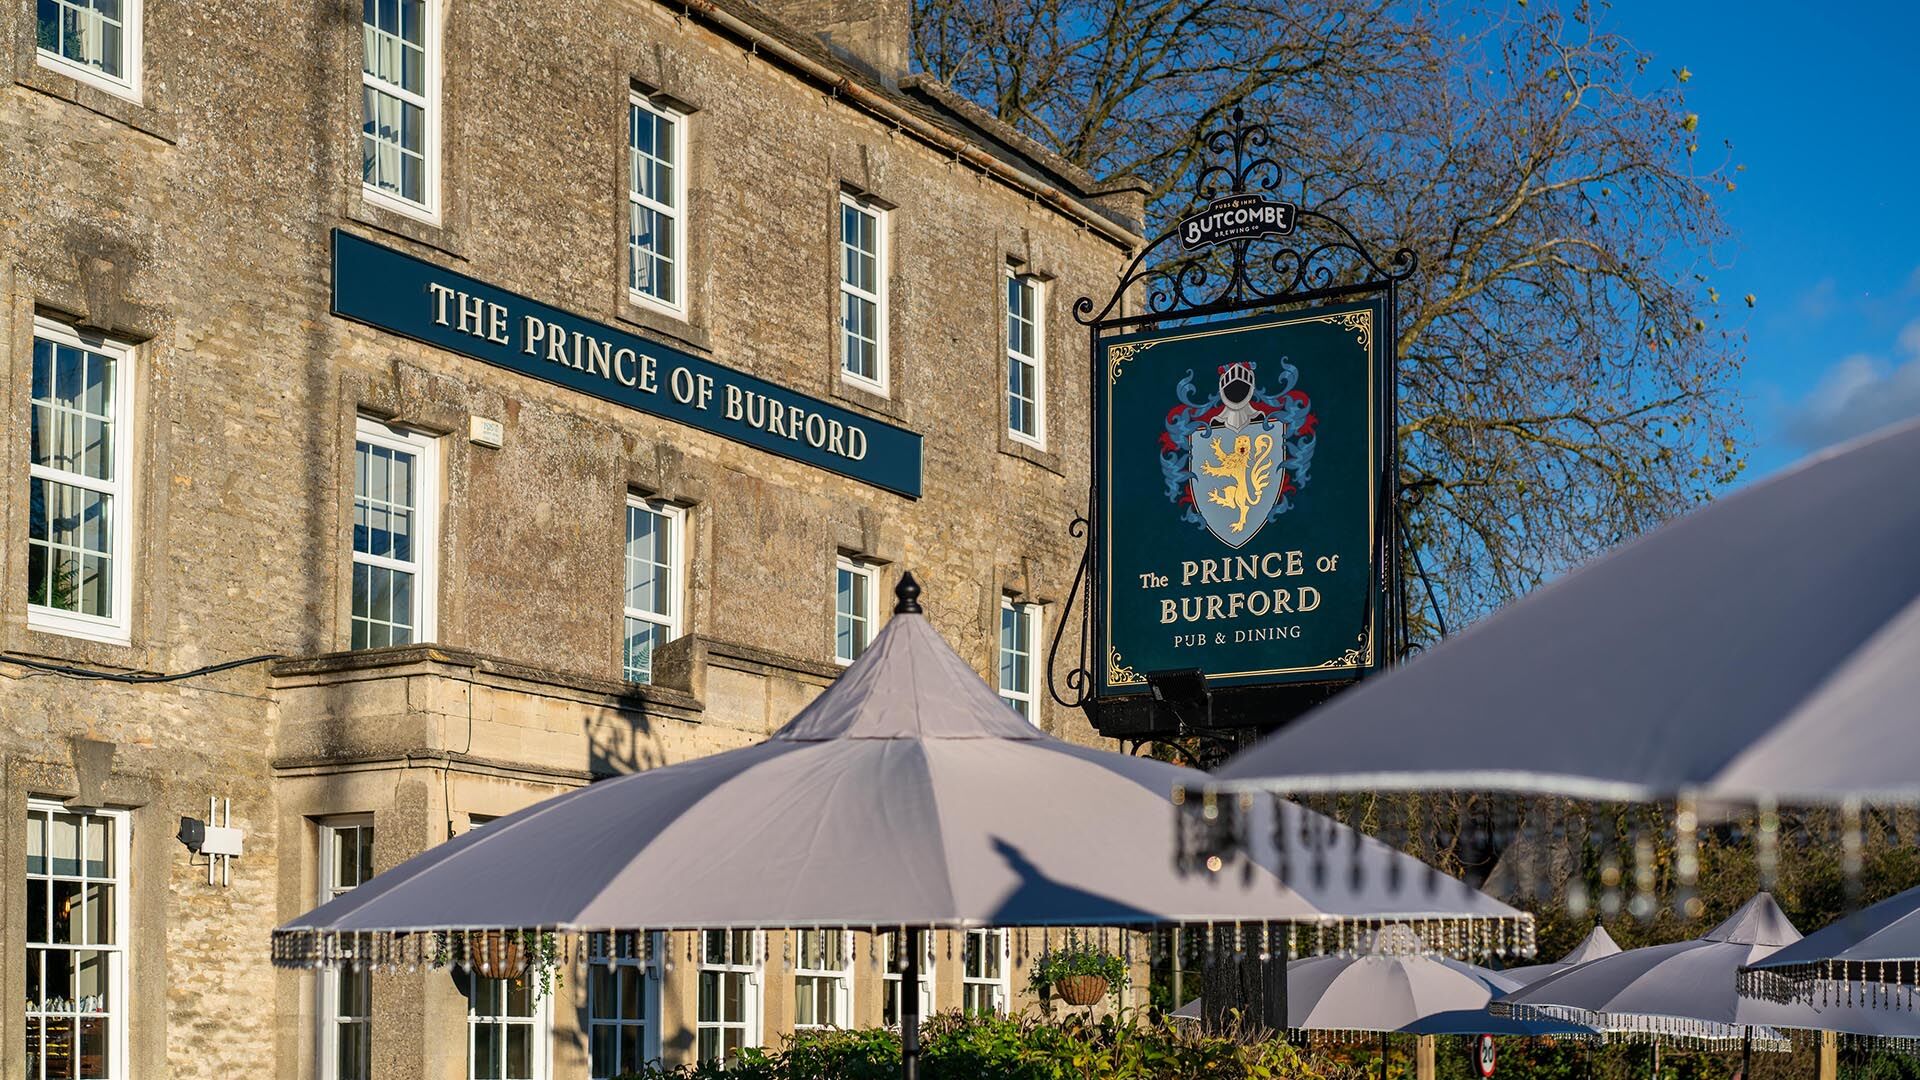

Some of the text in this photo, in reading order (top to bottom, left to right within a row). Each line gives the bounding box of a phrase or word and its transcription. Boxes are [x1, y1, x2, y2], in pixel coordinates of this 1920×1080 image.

[1185, 207, 1286, 243] BUTCOMBE
[1215, 227, 1250, 238] BREWING
[429, 282, 868, 462] THE PRINCE OF BURFORD
[1139, 550, 1340, 589] The PRINCE of
[1160, 586, 1321, 625] BURFORD
[1174, 625, 1301, 648] PUB & DINING
[1482, 1046, 1494, 1063] 20
